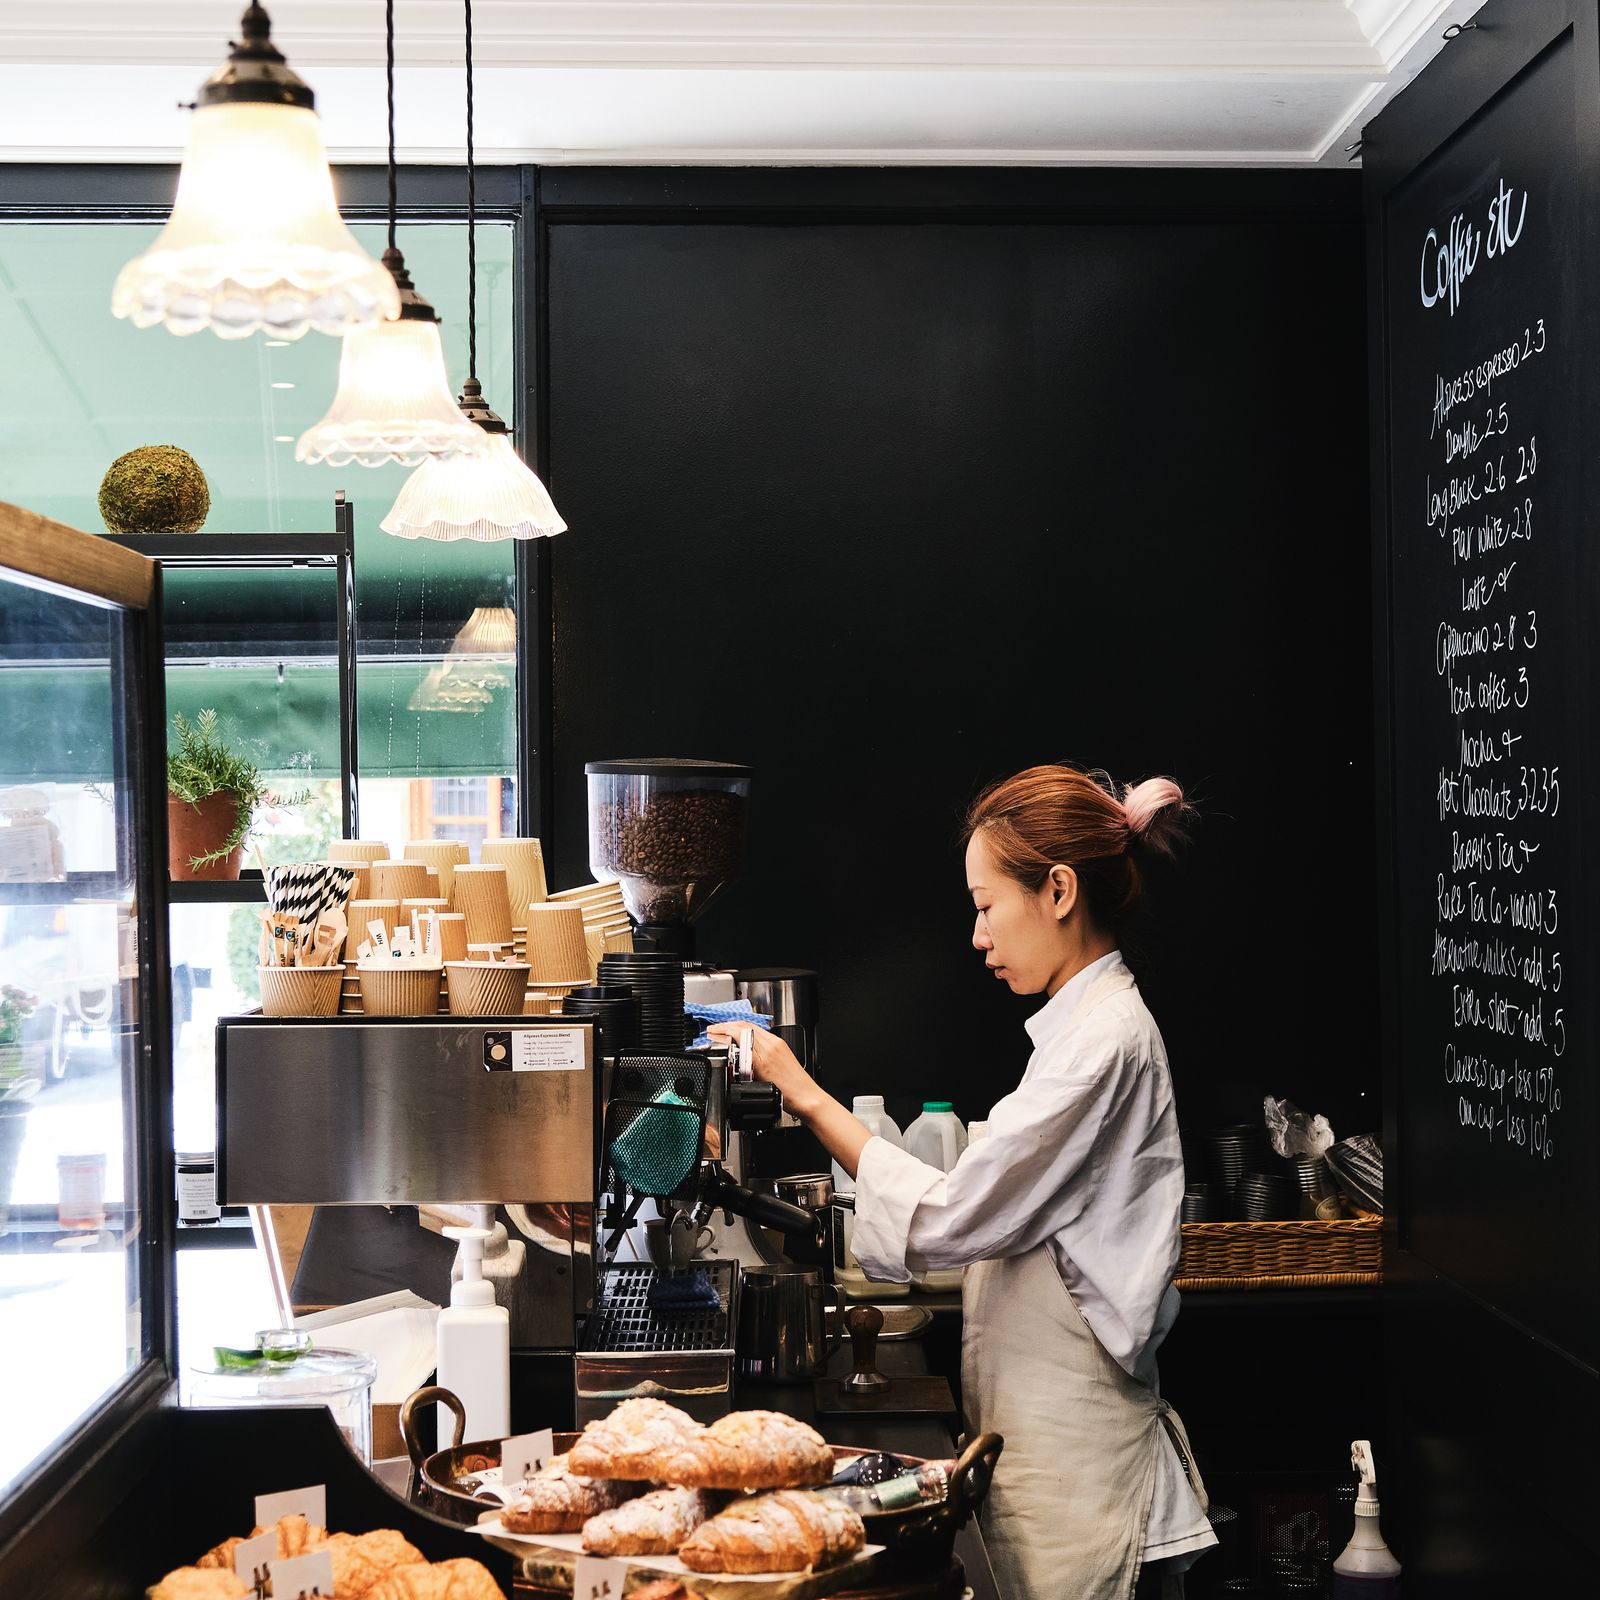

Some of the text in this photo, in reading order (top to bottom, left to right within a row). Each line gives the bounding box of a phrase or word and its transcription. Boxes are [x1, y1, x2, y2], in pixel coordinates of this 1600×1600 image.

[1420, 178, 1528, 317] Coffee etc
[1476, 342, 1520, 397] espresso
[1521, 318, 1546, 361] 2.3
[1446, 402, 1509, 464] Double 2.5
[1427, 435, 1537, 538] Long Black 2.6 2.8
[1511, 497, 1533, 541] 2.8
[1462, 575, 1497, 611] Latte
[1493, 615, 1517, 651] 2.8
[1523, 610, 1537, 649] 3
[1450, 666, 1529, 715] Iced coffee 3
[1458, 728, 1502, 777] Mocha
[1437, 766, 1459, 822] Hot
[1462, 773, 1521, 820] Chocolate
[1495, 832, 1523, 874] Tea
[1468, 881, 1488, 922] Tea
[1543, 888, 1558, 935] 3
[1523, 945, 1548, 991] add
[1453, 984, 1486, 1028] Extra
[1523, 996, 1548, 1047] add
[1489, 1063, 1506, 1106] cup
[1535, 1066, 1561, 1113] 15%
[1478, 1103, 1494, 1143] cup
[1506, 1104, 1526, 1146] less
[1530, 1113, 1553, 1160] 10%
